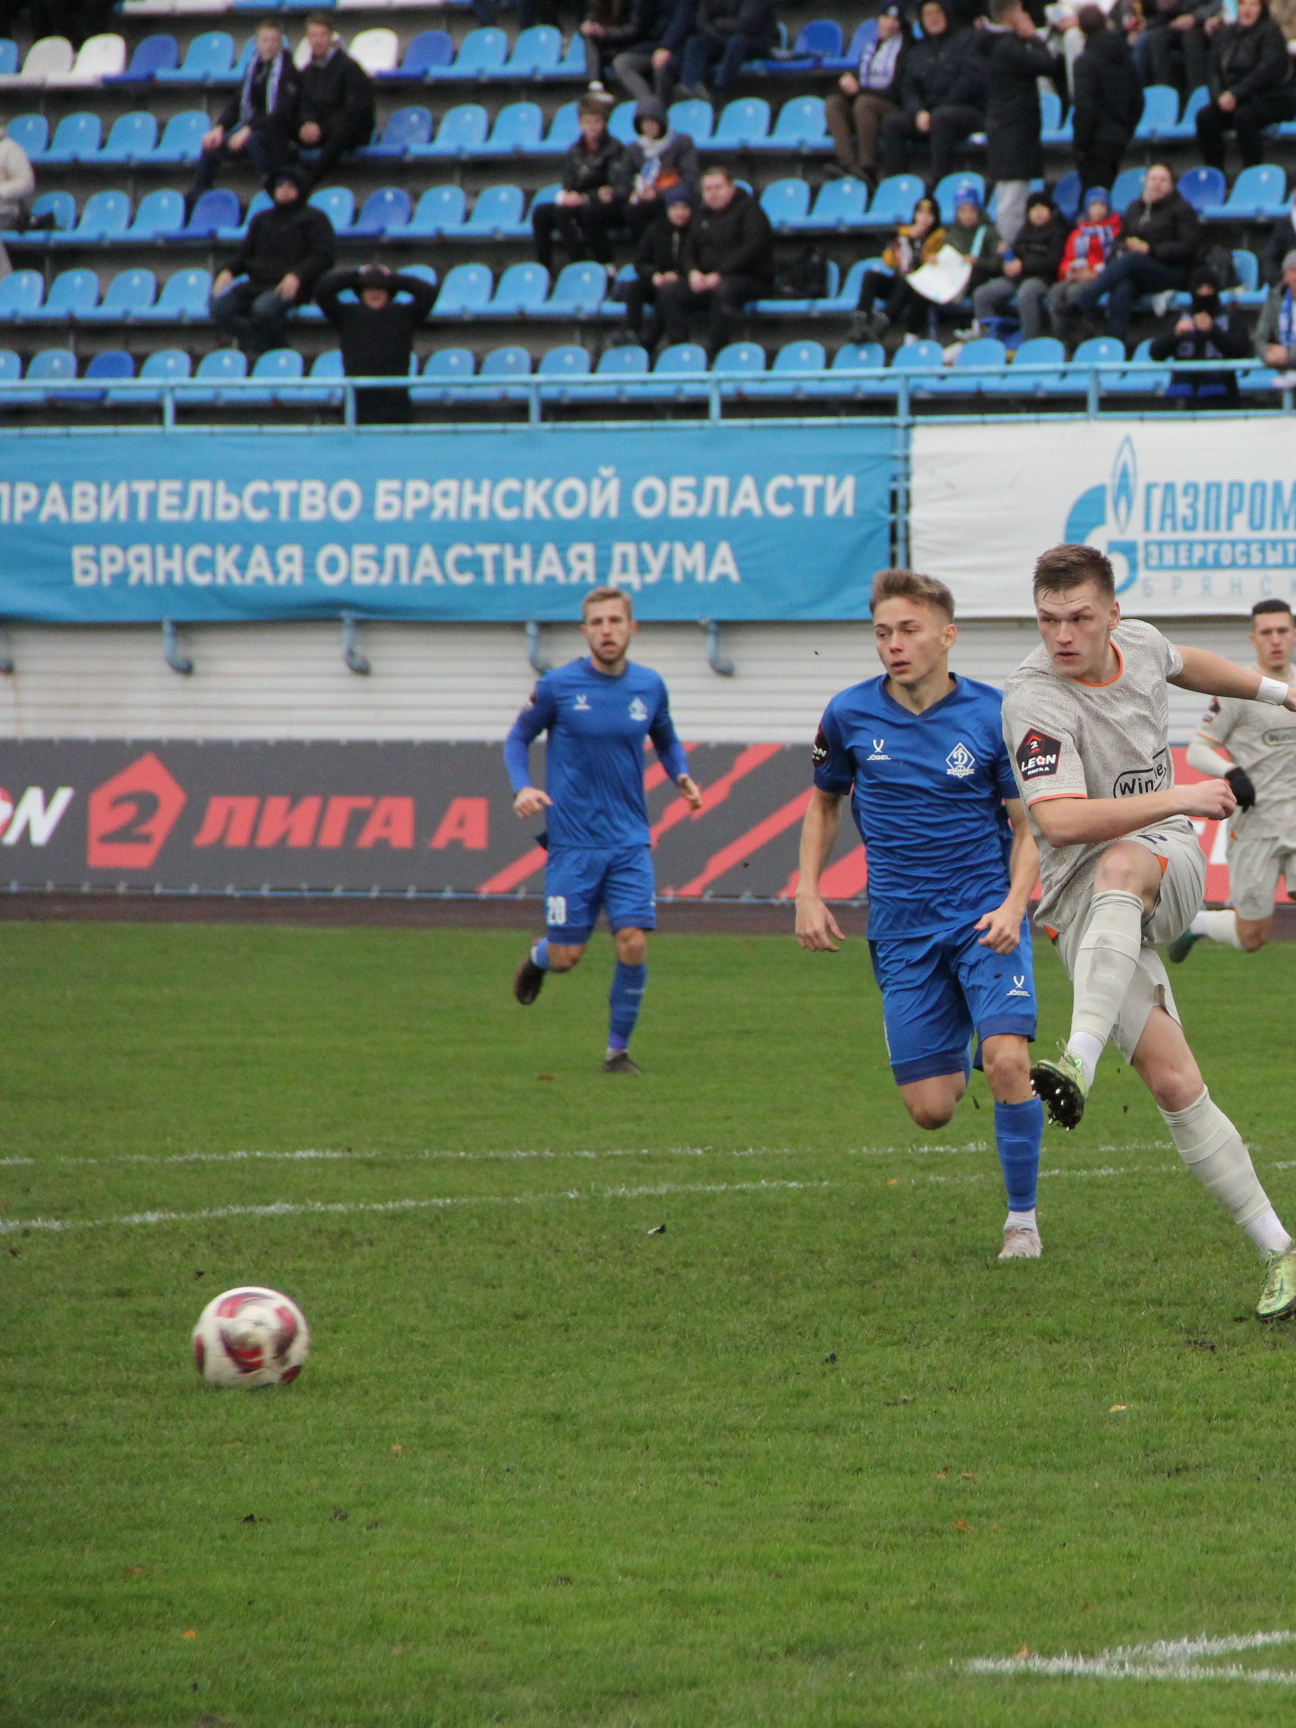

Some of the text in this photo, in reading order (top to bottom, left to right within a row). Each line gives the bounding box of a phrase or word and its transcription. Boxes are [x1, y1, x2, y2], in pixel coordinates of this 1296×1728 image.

[374, 468, 620, 522] БРЯНСКОЙ
[632, 475, 857, 520] ОБЛАСТИ
[72, 540, 741, 592] БРЯНСКАЯ ОБЛАСТНАЯ ДУМА
[1021, 754, 1057, 772] LEON
[193, 795, 415, 848] ЛИГА
[429, 797, 490, 849] А
